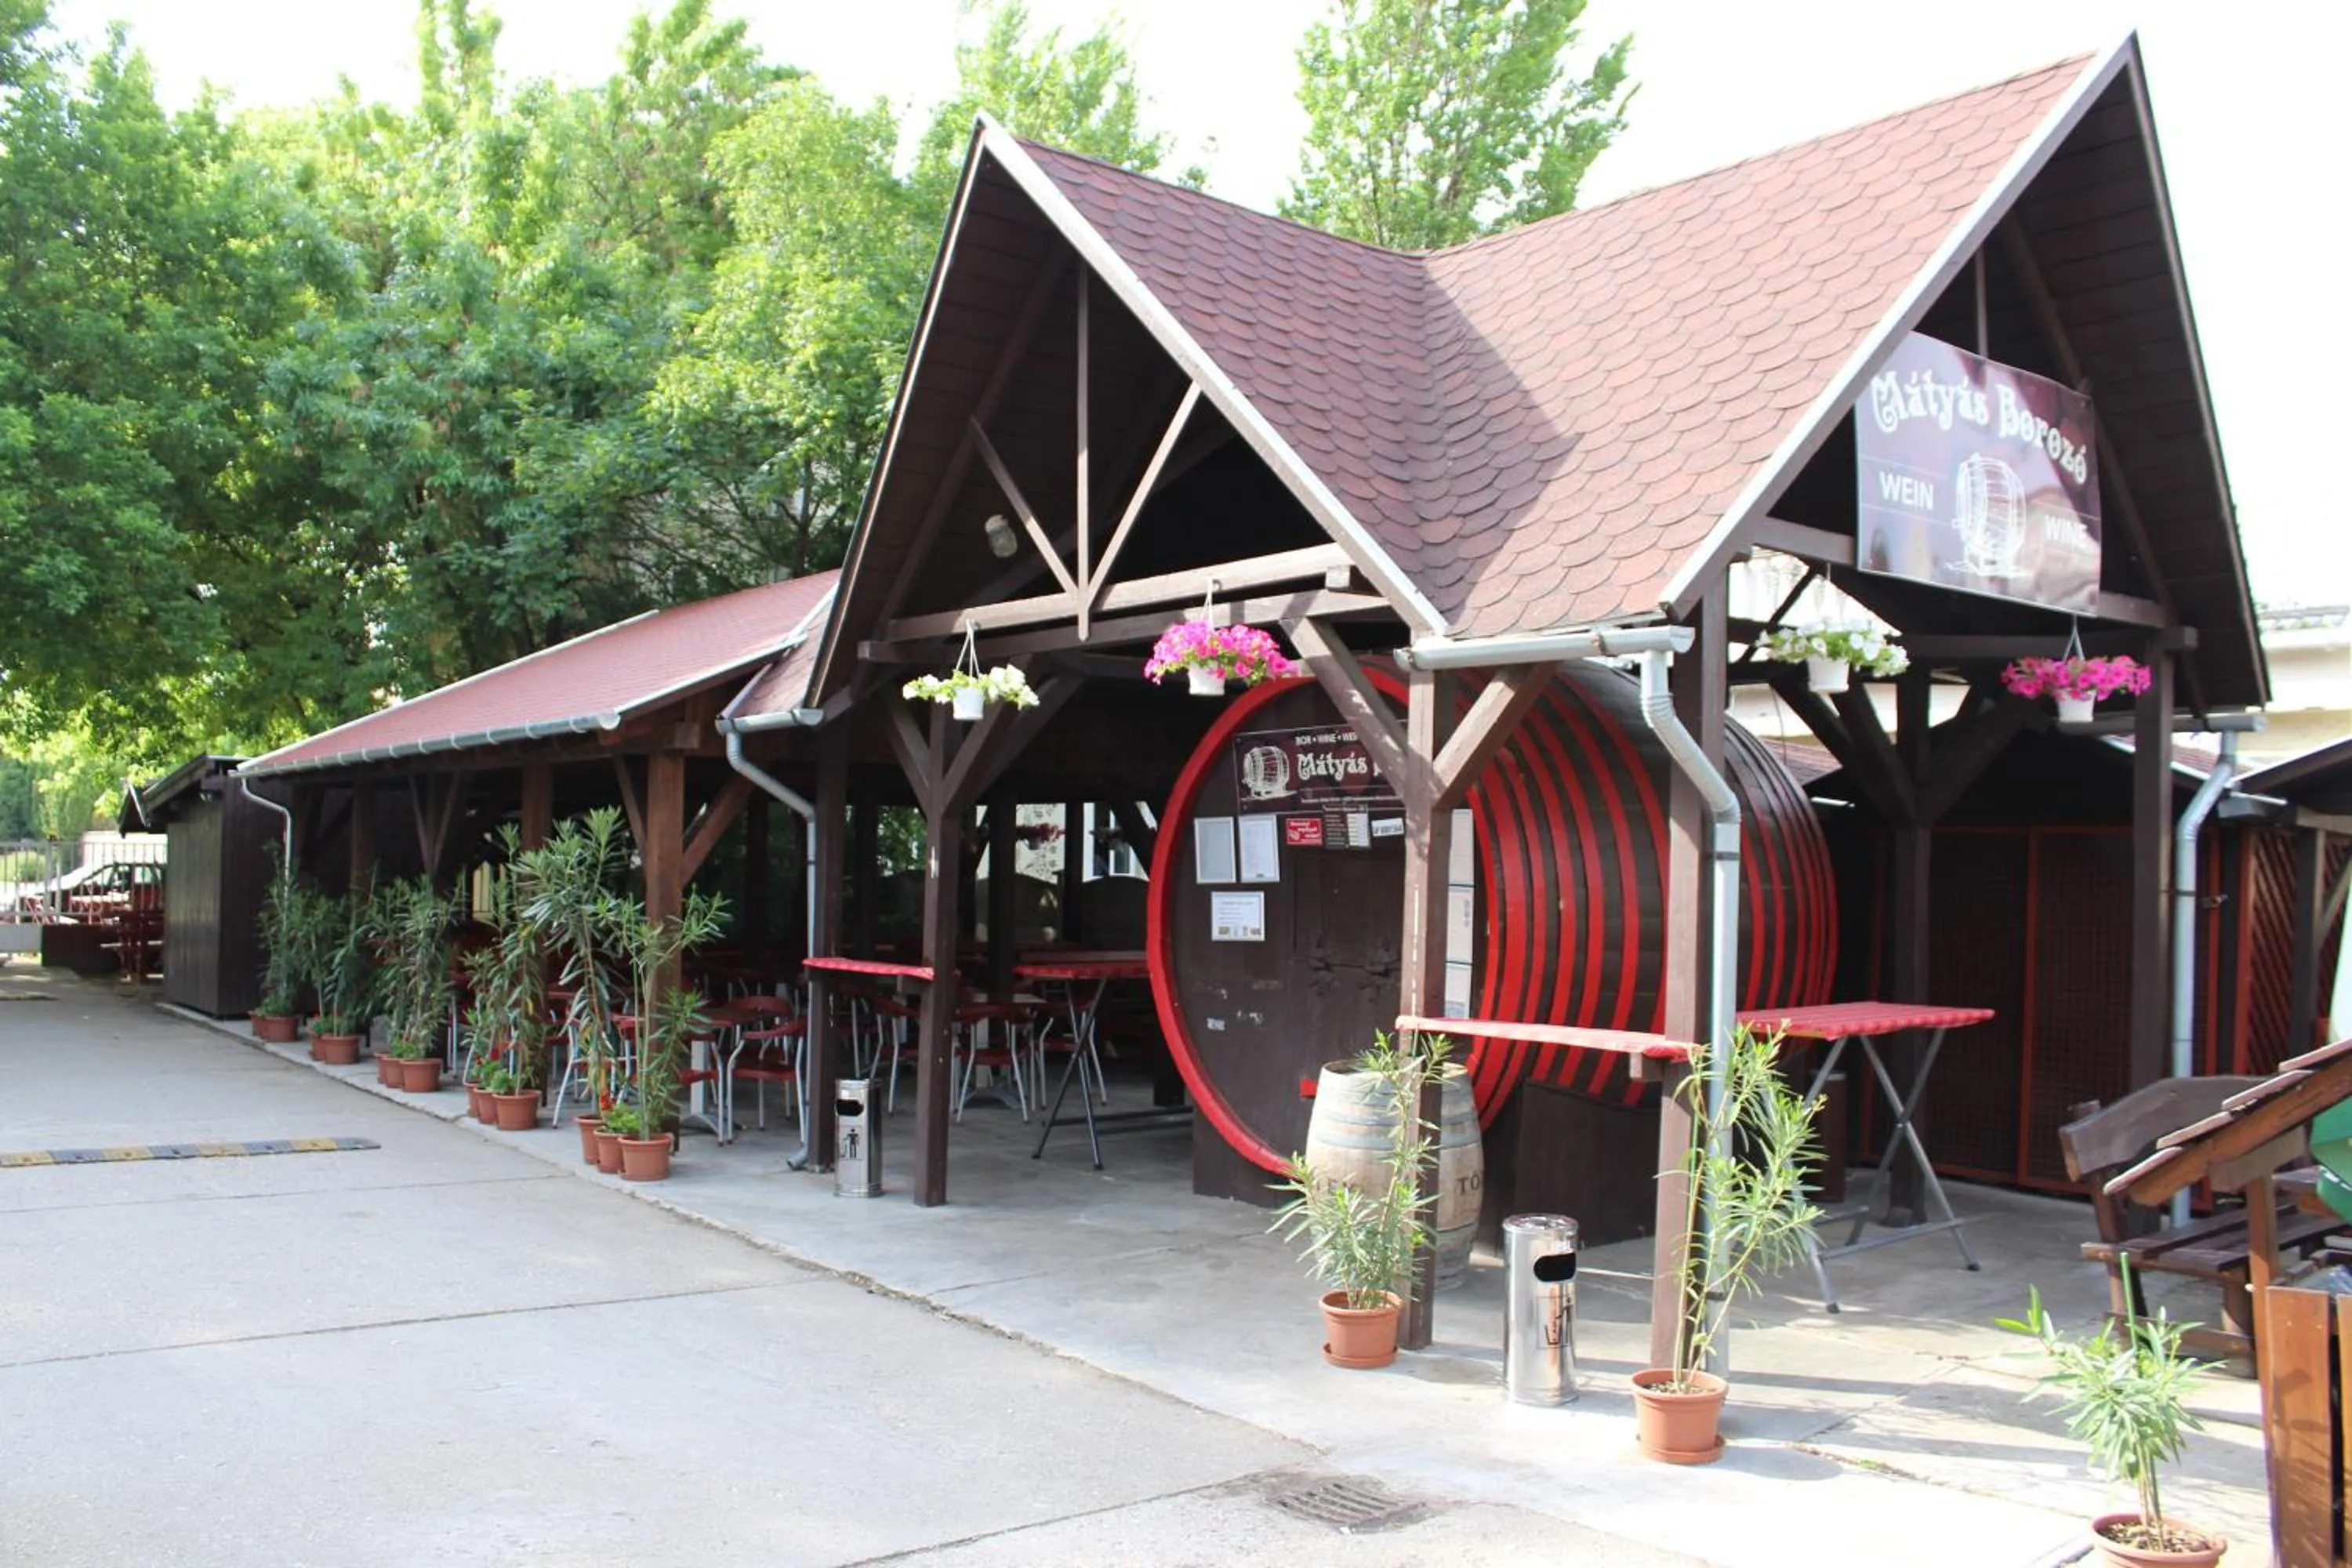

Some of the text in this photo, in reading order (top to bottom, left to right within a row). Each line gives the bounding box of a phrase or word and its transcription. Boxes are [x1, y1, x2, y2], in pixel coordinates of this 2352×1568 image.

[1870, 369, 2087, 484] Mátyás Borozó
[1880, 471, 1933, 510] WEIN
[2045, 514, 2088, 549] WINE
[1296, 752, 1368, 782] Mátyás
